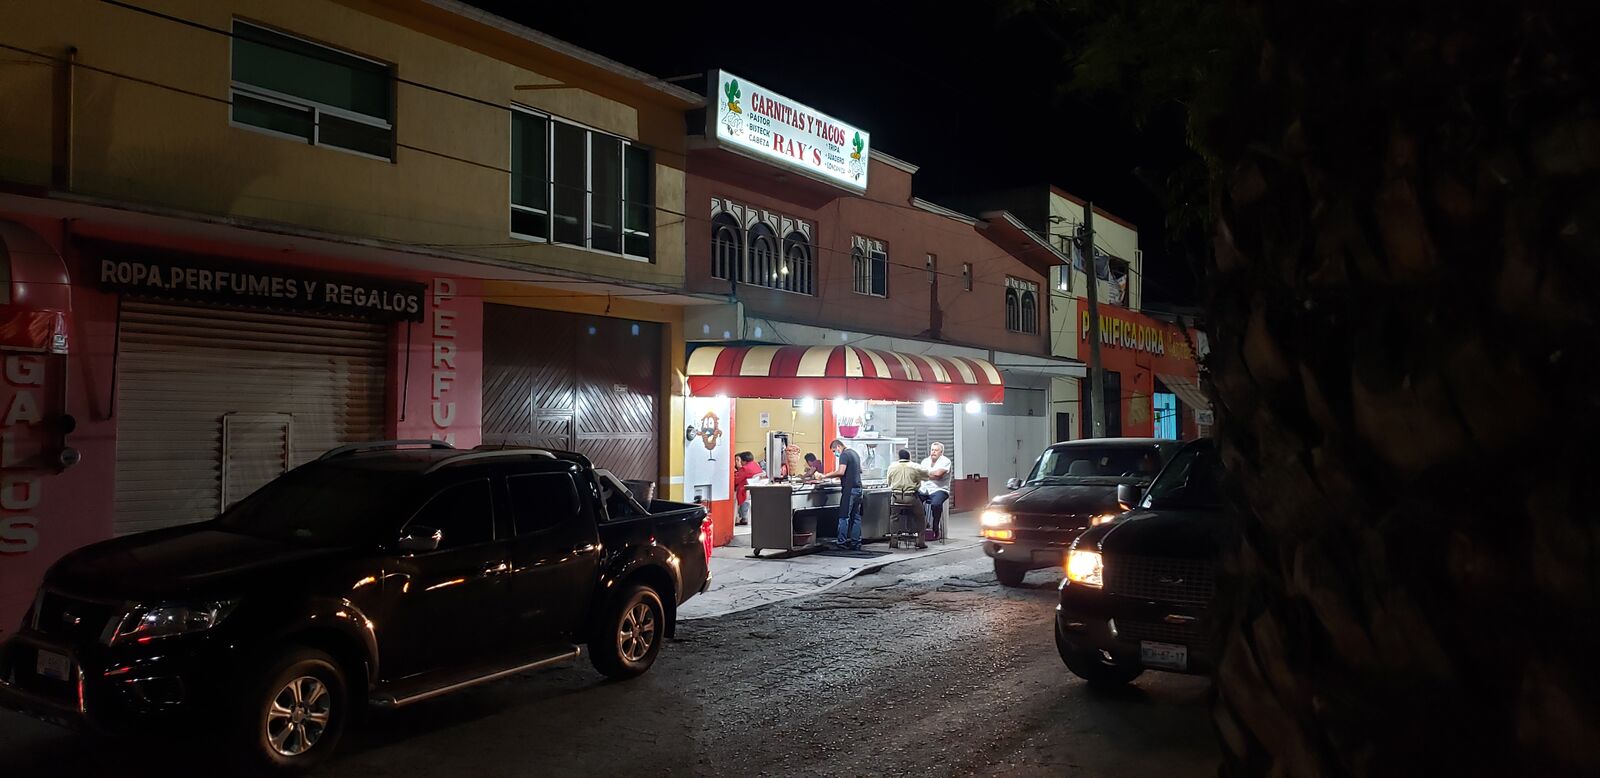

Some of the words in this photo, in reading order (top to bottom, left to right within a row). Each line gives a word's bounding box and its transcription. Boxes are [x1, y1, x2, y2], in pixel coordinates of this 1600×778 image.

[749, 123, 771, 138] BISTECK
[750, 112, 771, 127] PASTOR
[751, 92, 806, 131] CARNITAS
[807, 115, 815, 134] Y
[815, 120, 846, 146] TACOS
[749, 134, 770, 147] CABEZA
[304, 279, 317, 302] Y
[325, 283, 419, 314] REGALOS
[1082, 310, 1165, 355] PNIFICADORA
